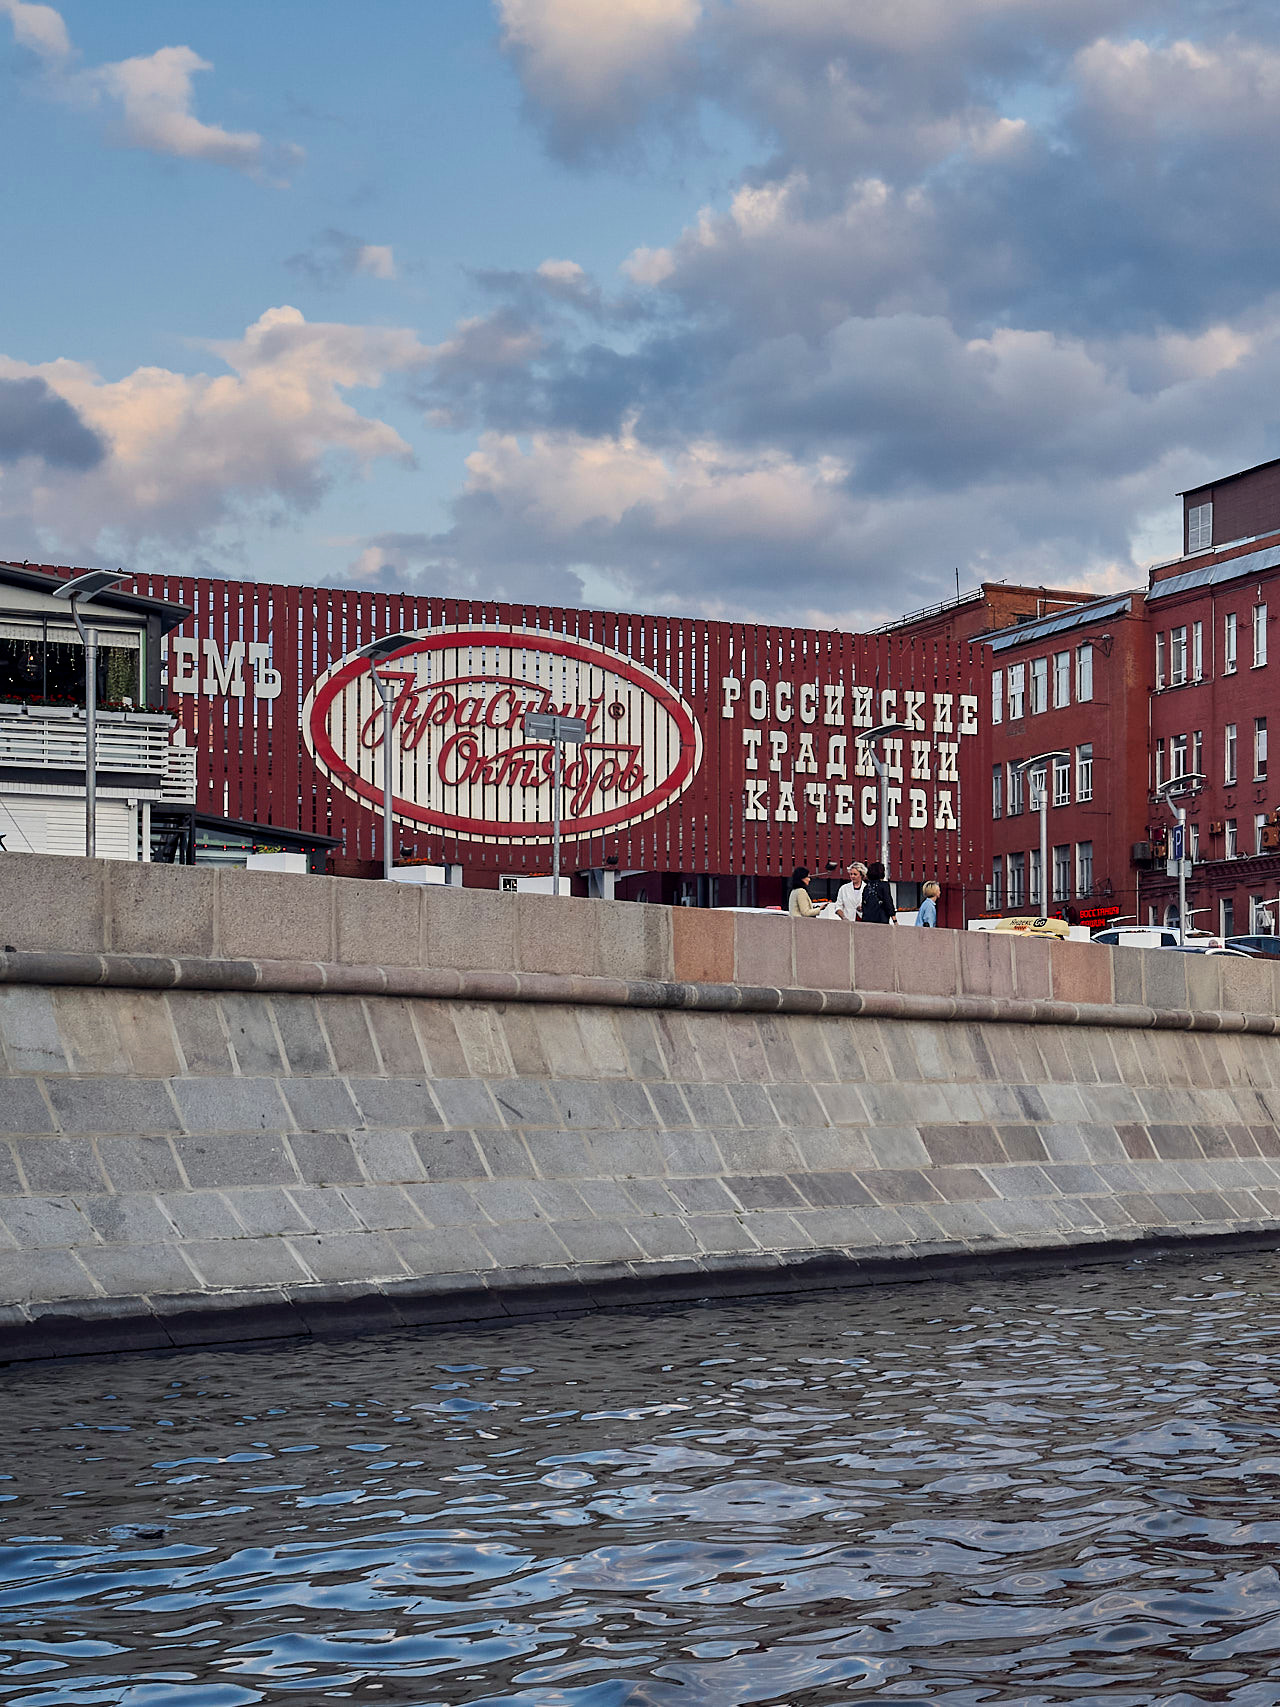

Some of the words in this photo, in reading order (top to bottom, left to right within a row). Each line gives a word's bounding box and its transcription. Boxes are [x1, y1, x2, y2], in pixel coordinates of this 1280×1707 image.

[161, 634, 282, 699] ЕМЪ
[722, 677, 978, 735] РОССИЙСКИЕ
[437, 731, 648, 817] Октябрь
[743, 728, 959, 784] ТРАДИЦИИ
[745, 779, 957, 830] КАЧЕСТВА
[1175, 830, 1182, 856] P
